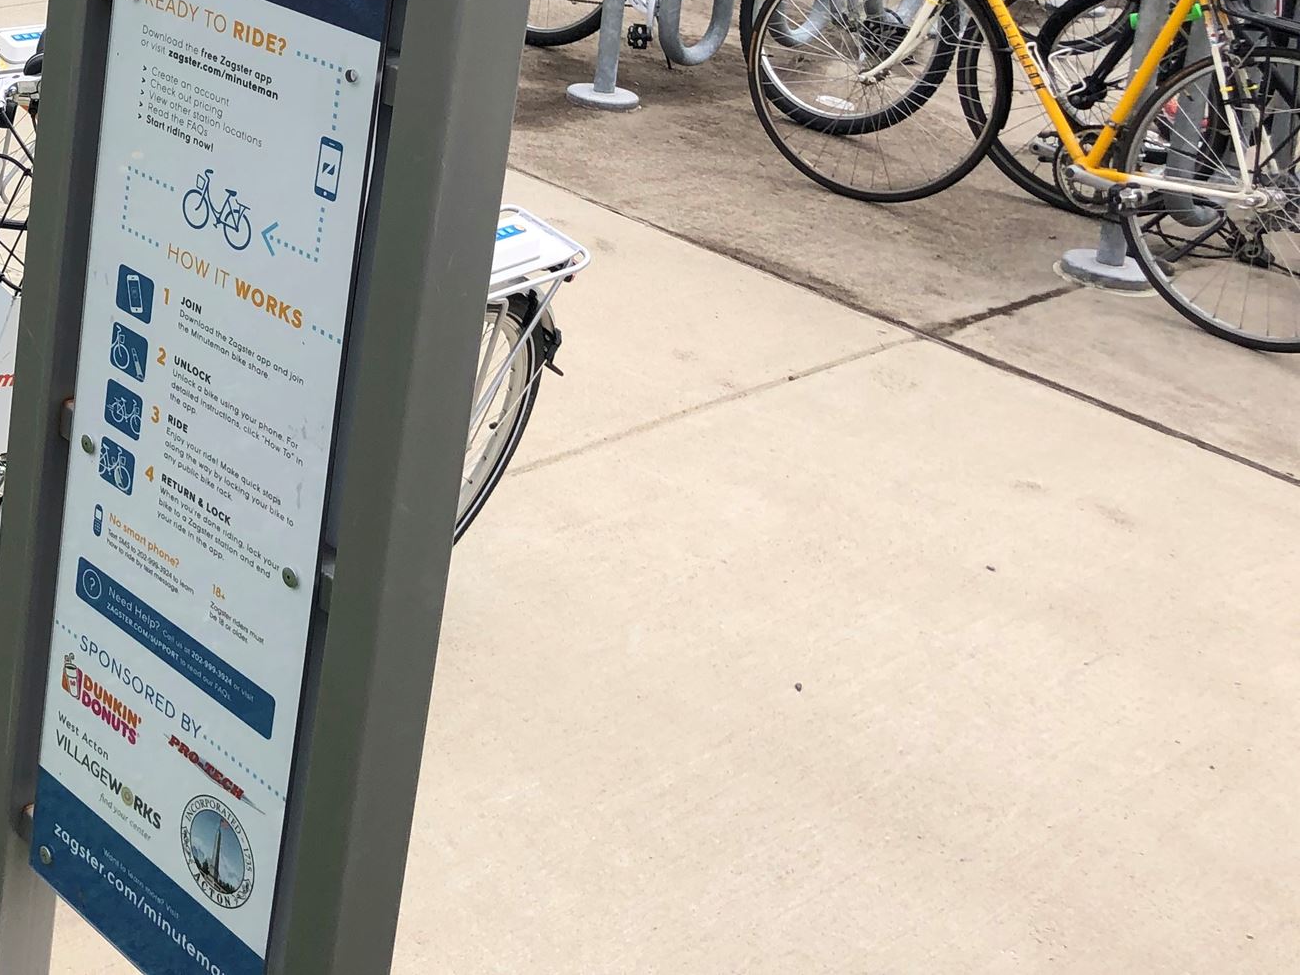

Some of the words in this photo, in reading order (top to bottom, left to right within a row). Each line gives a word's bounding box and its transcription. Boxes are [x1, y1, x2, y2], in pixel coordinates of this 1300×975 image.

[142, 24, 183, 49] Download
[185, 43, 199, 55] the
[201, 47, 218, 63] free
[220, 55, 252, 76] Zagster
[255, 70, 273, 86] app
[204, 8, 227, 33] TO
[233, 20, 288, 56] RIDE?
[140, 38, 149, 47] or
[150, 41, 166, 55] visit
[168, 49, 279, 101] zagster.com/minuteman
[151, 66, 179, 86] Create
[180, 80, 192, 91] an
[194, 86, 230, 107] account
[147, 102, 169, 120] Read
[171, 113, 184, 126] the
[186, 119, 208, 137] FAQs
[149, 90, 168, 106] View
[169, 100, 191, 116] other
[192, 110, 220, 130] station
[222, 122, 262, 148] locations
[150, 78, 176, 97] Check
[178, 91, 192, 105] out
[193, 98, 223, 120] pricing
[146, 114, 165, 131] Start
[166, 124, 191, 144] riding
[193, 135, 214, 152] now!
[163, 288, 170, 305] 1
[180, 296, 202, 315] JOIN
[167, 242, 210, 279] HOW
[213, 267, 230, 289] IT
[235, 277, 303, 329] WORKS
[156, 347, 167, 367] 2
[174, 355, 212, 385] UNLOCK
[177, 321, 189, 334] the
[190, 329, 230, 357] Minuteman
[231, 351, 247, 367] bike
[248, 362, 270, 381] share.
[179, 309, 214, 335] Download
[215, 330, 228, 343] the
[228, 336, 255, 358] Zagster
[256, 353, 272, 367] app
[273, 363, 289, 377] and
[289, 371, 304, 386] join
[151, 405, 160, 424] 3
[167, 413, 188, 434] RIDE
[169, 393, 181, 406] the
[171, 382, 199, 403] detailed
[200, 398, 241, 430] instructions,
[243, 425, 260, 441] click
[296, 456, 304, 467] in
[172, 369, 196, 390] Unlock
[197, 385, 203, 393] a
[203, 387, 219, 402] bike
[220, 398, 240, 416] using
[241, 410, 257, 425] your
[258, 421, 285, 441] phone.
[286, 436, 299, 450] For
[163, 452, 177, 465] any
[177, 461, 200, 480] public
[200, 475, 215, 490] bike
[164, 440, 185, 459] along
[186, 452, 197, 465] the
[198, 462, 213, 476] way
[213, 469, 223, 483] by
[223, 477, 250, 501] locking
[251, 494, 268, 511] your
[269, 506, 285, 522] bike
[286, 517, 294, 527] to
[166, 426, 185, 445] Enjoy
[186, 441, 201, 455] your
[202, 449, 219, 465] ride!
[220, 461, 240, 479] Make
[241, 475, 261, 493] quick
[262, 488, 282, 506] stops
[145, 465, 154, 482] 4
[161, 473, 196, 503] RETURN
[197, 497, 204, 508] &
[206, 502, 231, 526] LOCK
[109, 513, 121, 528] No
[123, 524, 146, 544] smart
[147, 541, 180, 568] phone?
[157, 510, 172, 524] your
[173, 521, 187, 535] ride
[188, 531, 195, 541] in
[196, 536, 207, 549] the
[209, 546, 224, 561] app.
[158, 498, 173, 512] bike
[174, 508, 180, 518] to
[188, 517, 214, 539] Zagster
[215, 536, 238, 557] station
[240, 552, 255, 568] and
[256, 563, 271, 579] end
[160, 486, 179, 504] When
[202, 516, 221, 532] done
[246, 543, 261, 559] lock
[263, 556, 280, 571] your
[108, 586, 133, 612] Need
[134, 604, 160, 631] Help?
[212, 584, 226, 601] 18+
[209, 601, 232, 622] Zagster
[232, 616, 249, 633] riders
[250, 629, 265, 645] must
[79, 635, 176, 718] SPONSORED
[180, 713, 202, 739] BY
[83, 673, 142, 728] DUNKIN'
[58, 710, 80, 736] West
[81, 733, 109, 761] Acton
[81, 690, 138, 745] DONUTS
[56, 729, 162, 830] VILLAGEWORKS
[99, 793, 113, 810] find
[113, 807, 129, 823] your
[129, 818, 151, 841] center
[184, 797, 242, 835] INCORPORATED
[54, 823, 225, 975] zagster.com/minutema
[193, 873, 232, 907] ACTON
